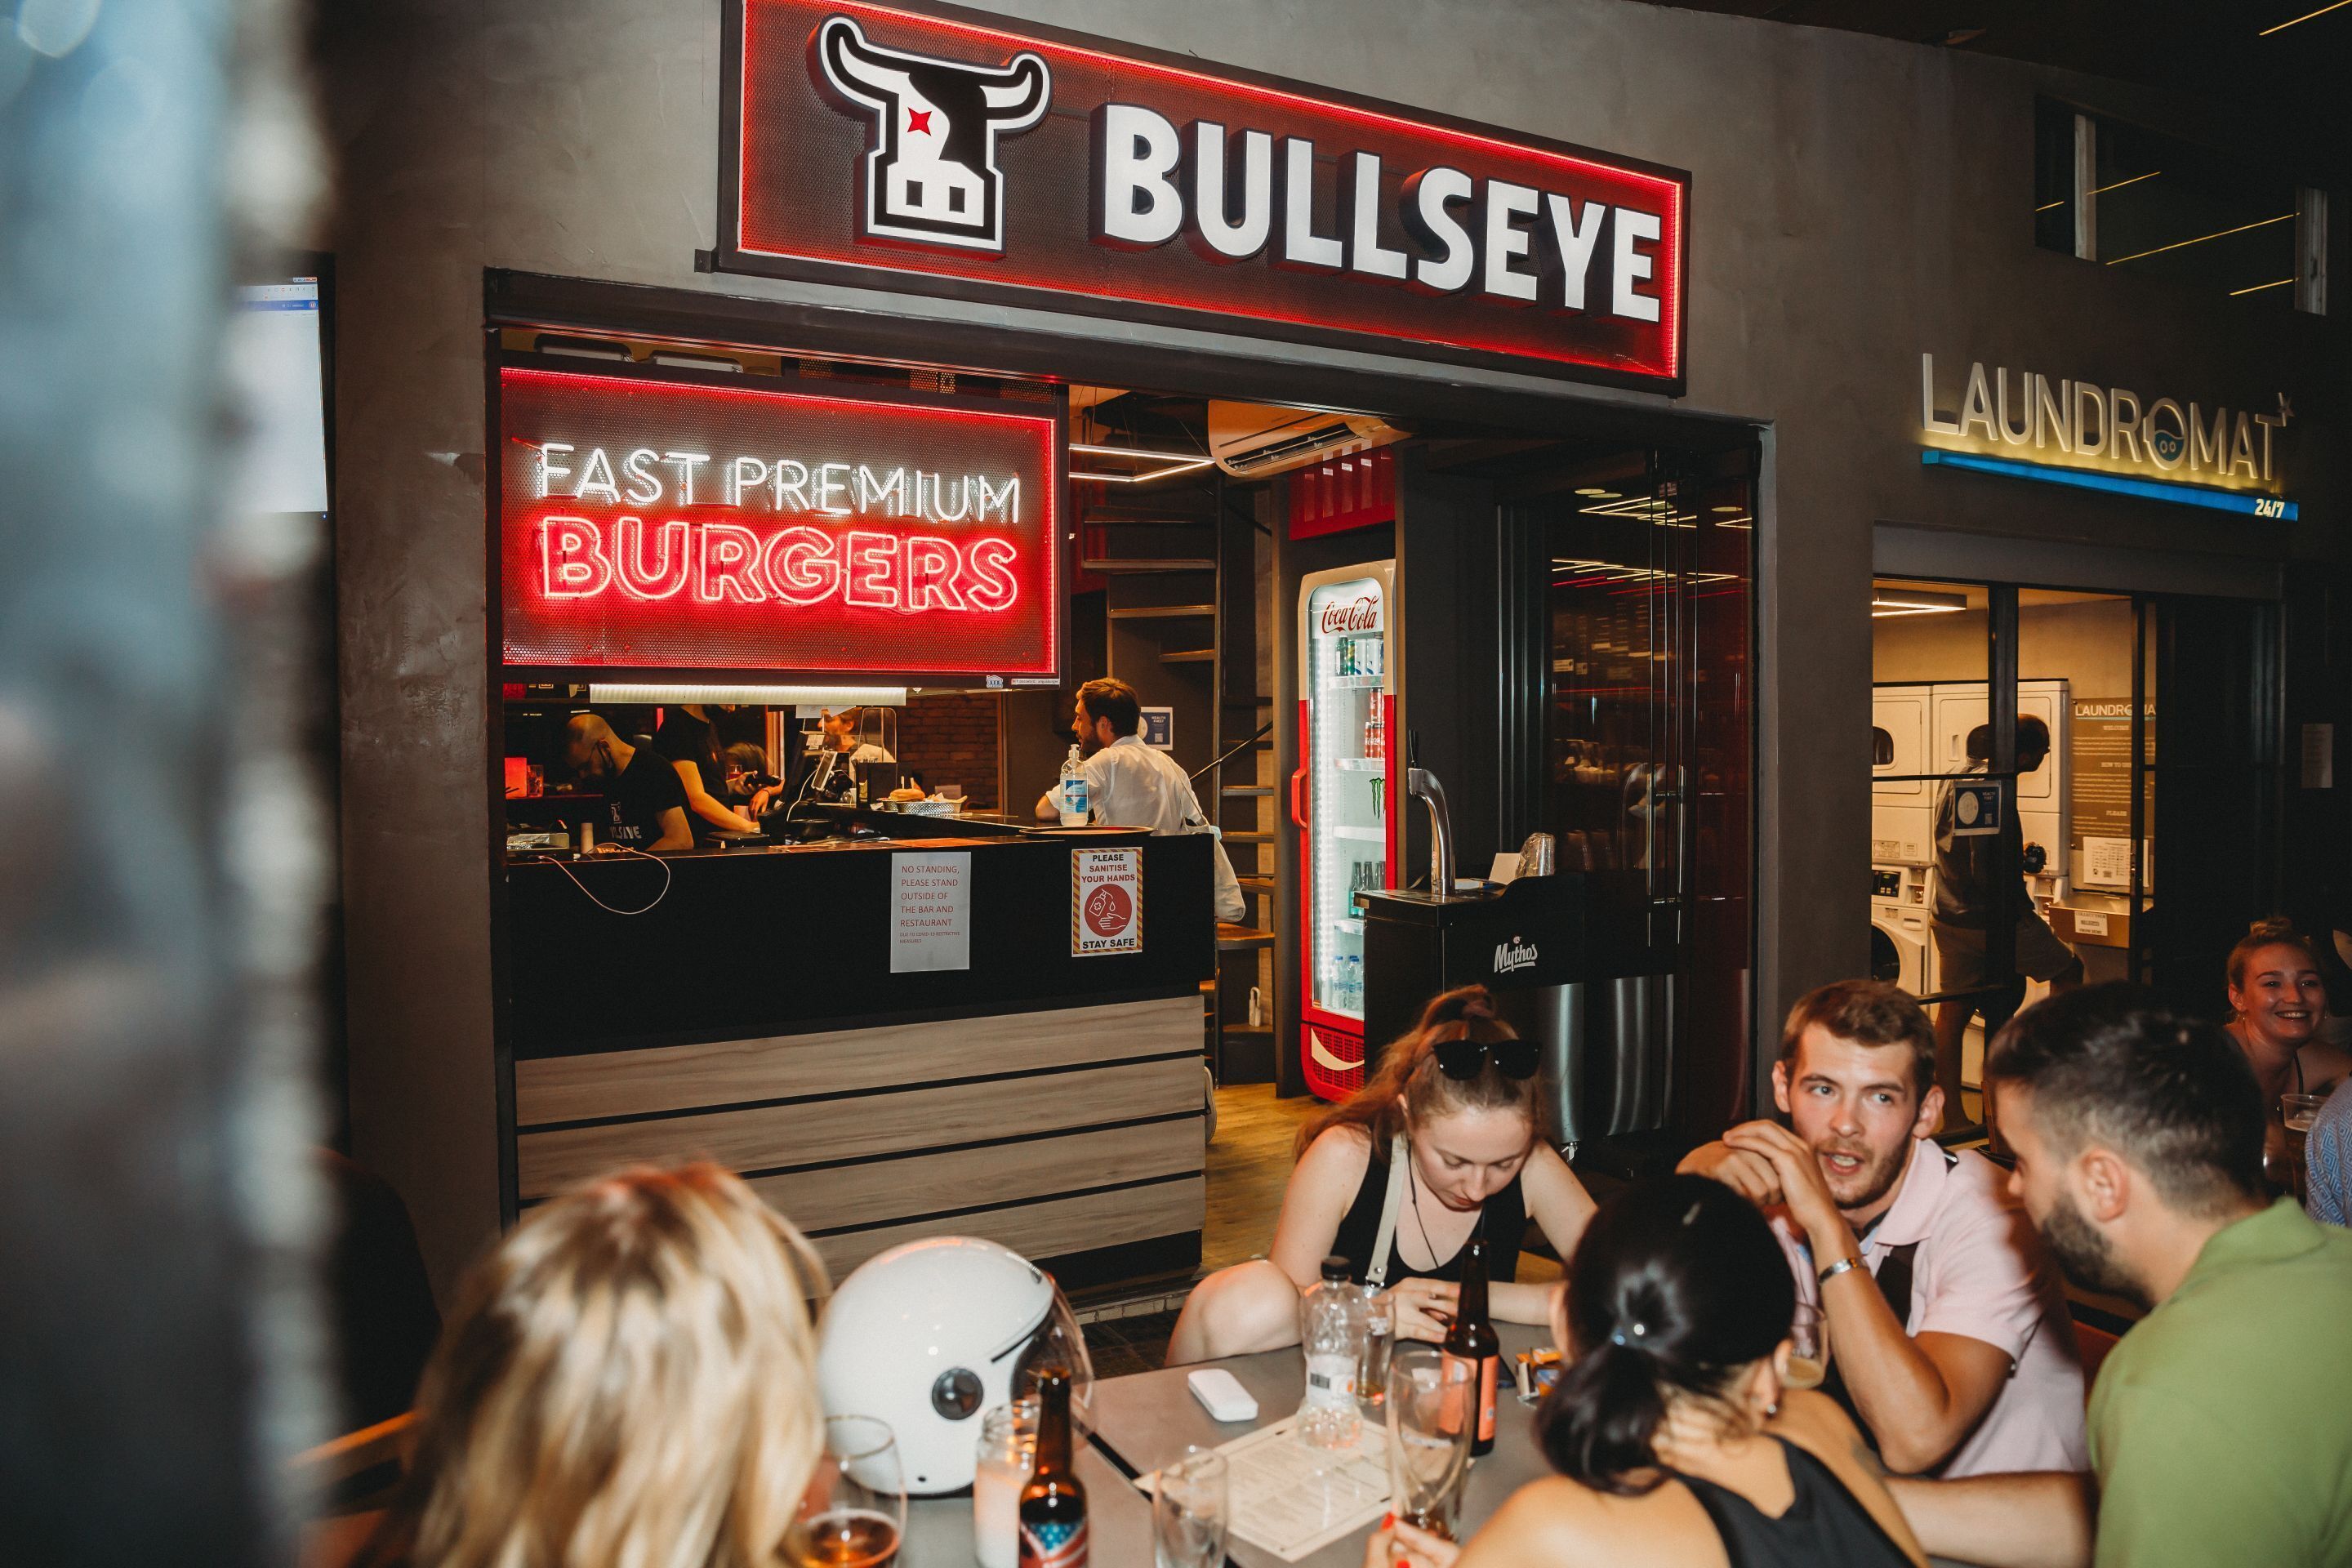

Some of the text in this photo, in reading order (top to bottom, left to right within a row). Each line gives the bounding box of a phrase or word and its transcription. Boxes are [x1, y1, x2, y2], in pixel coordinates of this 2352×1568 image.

[1102, 103, 1661, 322] BULLSEYE
[1922, 353, 2287, 480] LAUNDROMAT
[541, 443, 1021, 523] FAST PREMIUM
[2254, 498, 2286, 519] 24/7
[542, 516, 1018, 612] BURGERS
[1093, 853, 1124, 862] PLEASE
[902, 866, 960, 875] NO STANDING,
[1089, 864, 1128, 872] SANITISE
[1107, 874, 1135, 882] HANDS
[901, 879, 958, 887] PLEASE STAND
[901, 892, 948, 900] OUTSIDE OF
[901, 905, 954, 914] THE BAR AND
[900, 919, 952, 927] RESTAURANT
[1082, 938, 1134, 949] STAY SAFE
[1494, 942, 1538, 973] Mythos
